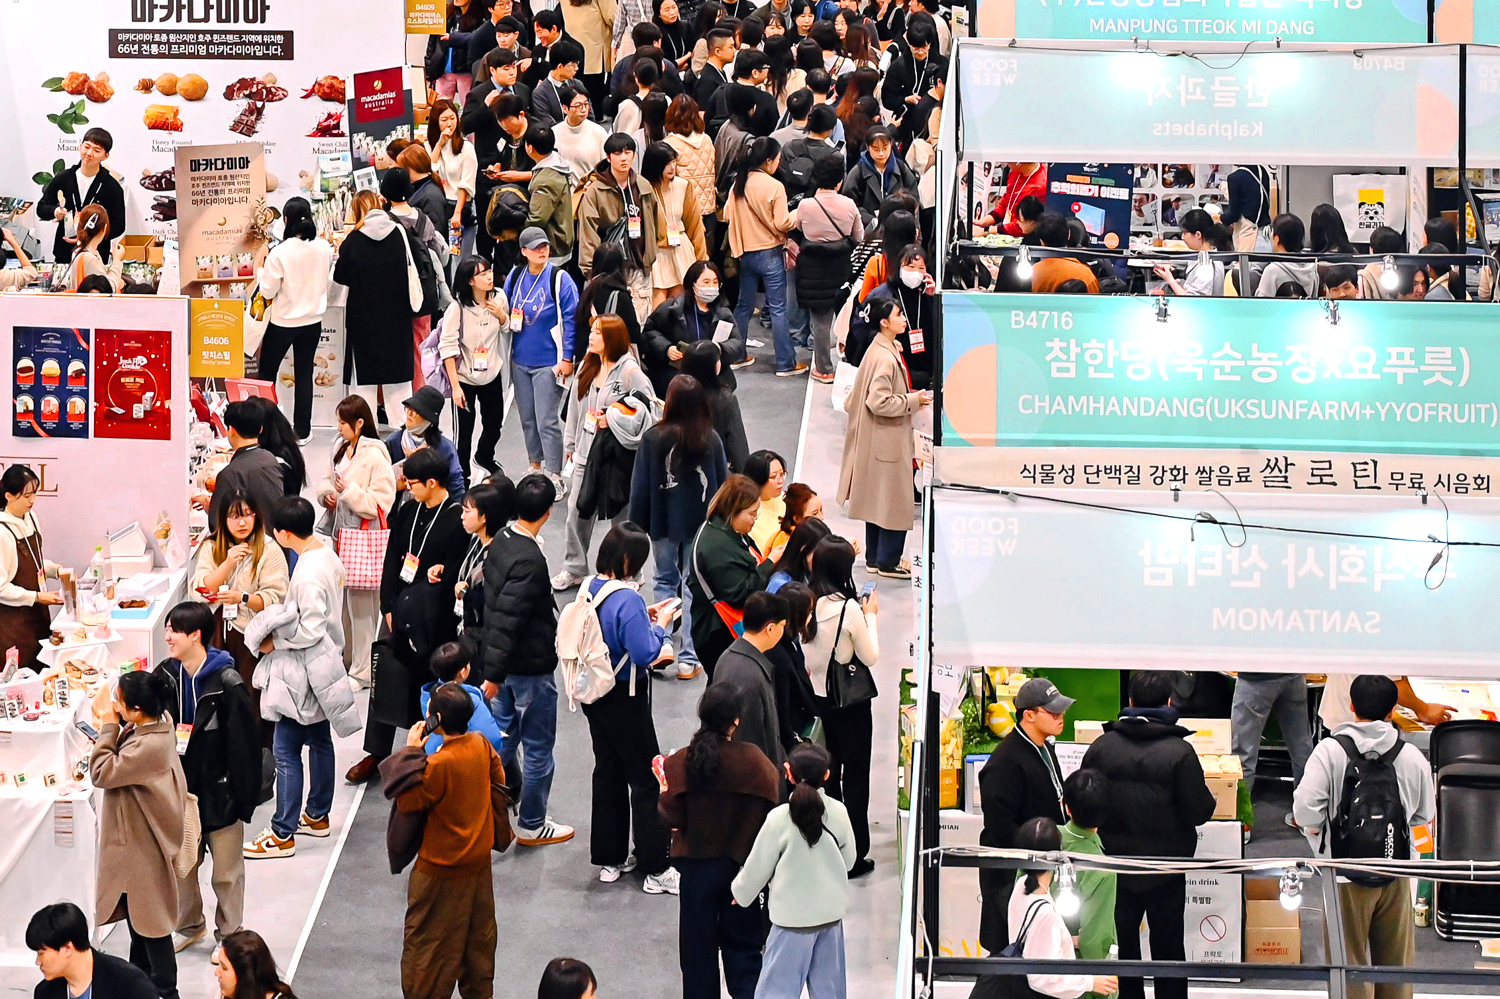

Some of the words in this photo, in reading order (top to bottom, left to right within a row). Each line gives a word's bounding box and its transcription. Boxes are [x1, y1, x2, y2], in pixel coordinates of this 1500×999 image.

[1089, 18, 1179, 34] MANPUNG
[1182, 19, 1238, 34] TTEOK
[1240, 19, 1262, 35] MI
[1265, 19, 1316, 36] DANG
[117, 32, 153, 43] 마카다미아
[168, 32, 197, 43] 원산지인
[197, 32, 212, 43] 호주
[241, 33, 263, 44] 지역에
[263, 33, 284, 44] 위치한
[117, 43, 139, 55] 66년
[140, 43, 168, 56] 전통의
[170, 43, 207, 56] 프리미엄
[208, 44, 284, 57] 마카다미아입니다.
[189, 156, 251, 173] 마카다미아
[1010, 310, 1074, 331] B4716
[203, 336, 230, 345] B4606
[1017, 393, 1499, 428] CHAMHANDANG(UKSUNFARM+YYOFRUIT)
[1019, 464, 1077, 486] 식물성
[1082, 464, 1142, 486] 단백질
[1149, 464, 1189, 487] 강화
[1194, 464, 1253, 487] 쌀음료
[1387, 472, 1425, 492] 무료
[1433, 473, 1492, 494] 시음회
[1198, 877, 1220, 888] drink
